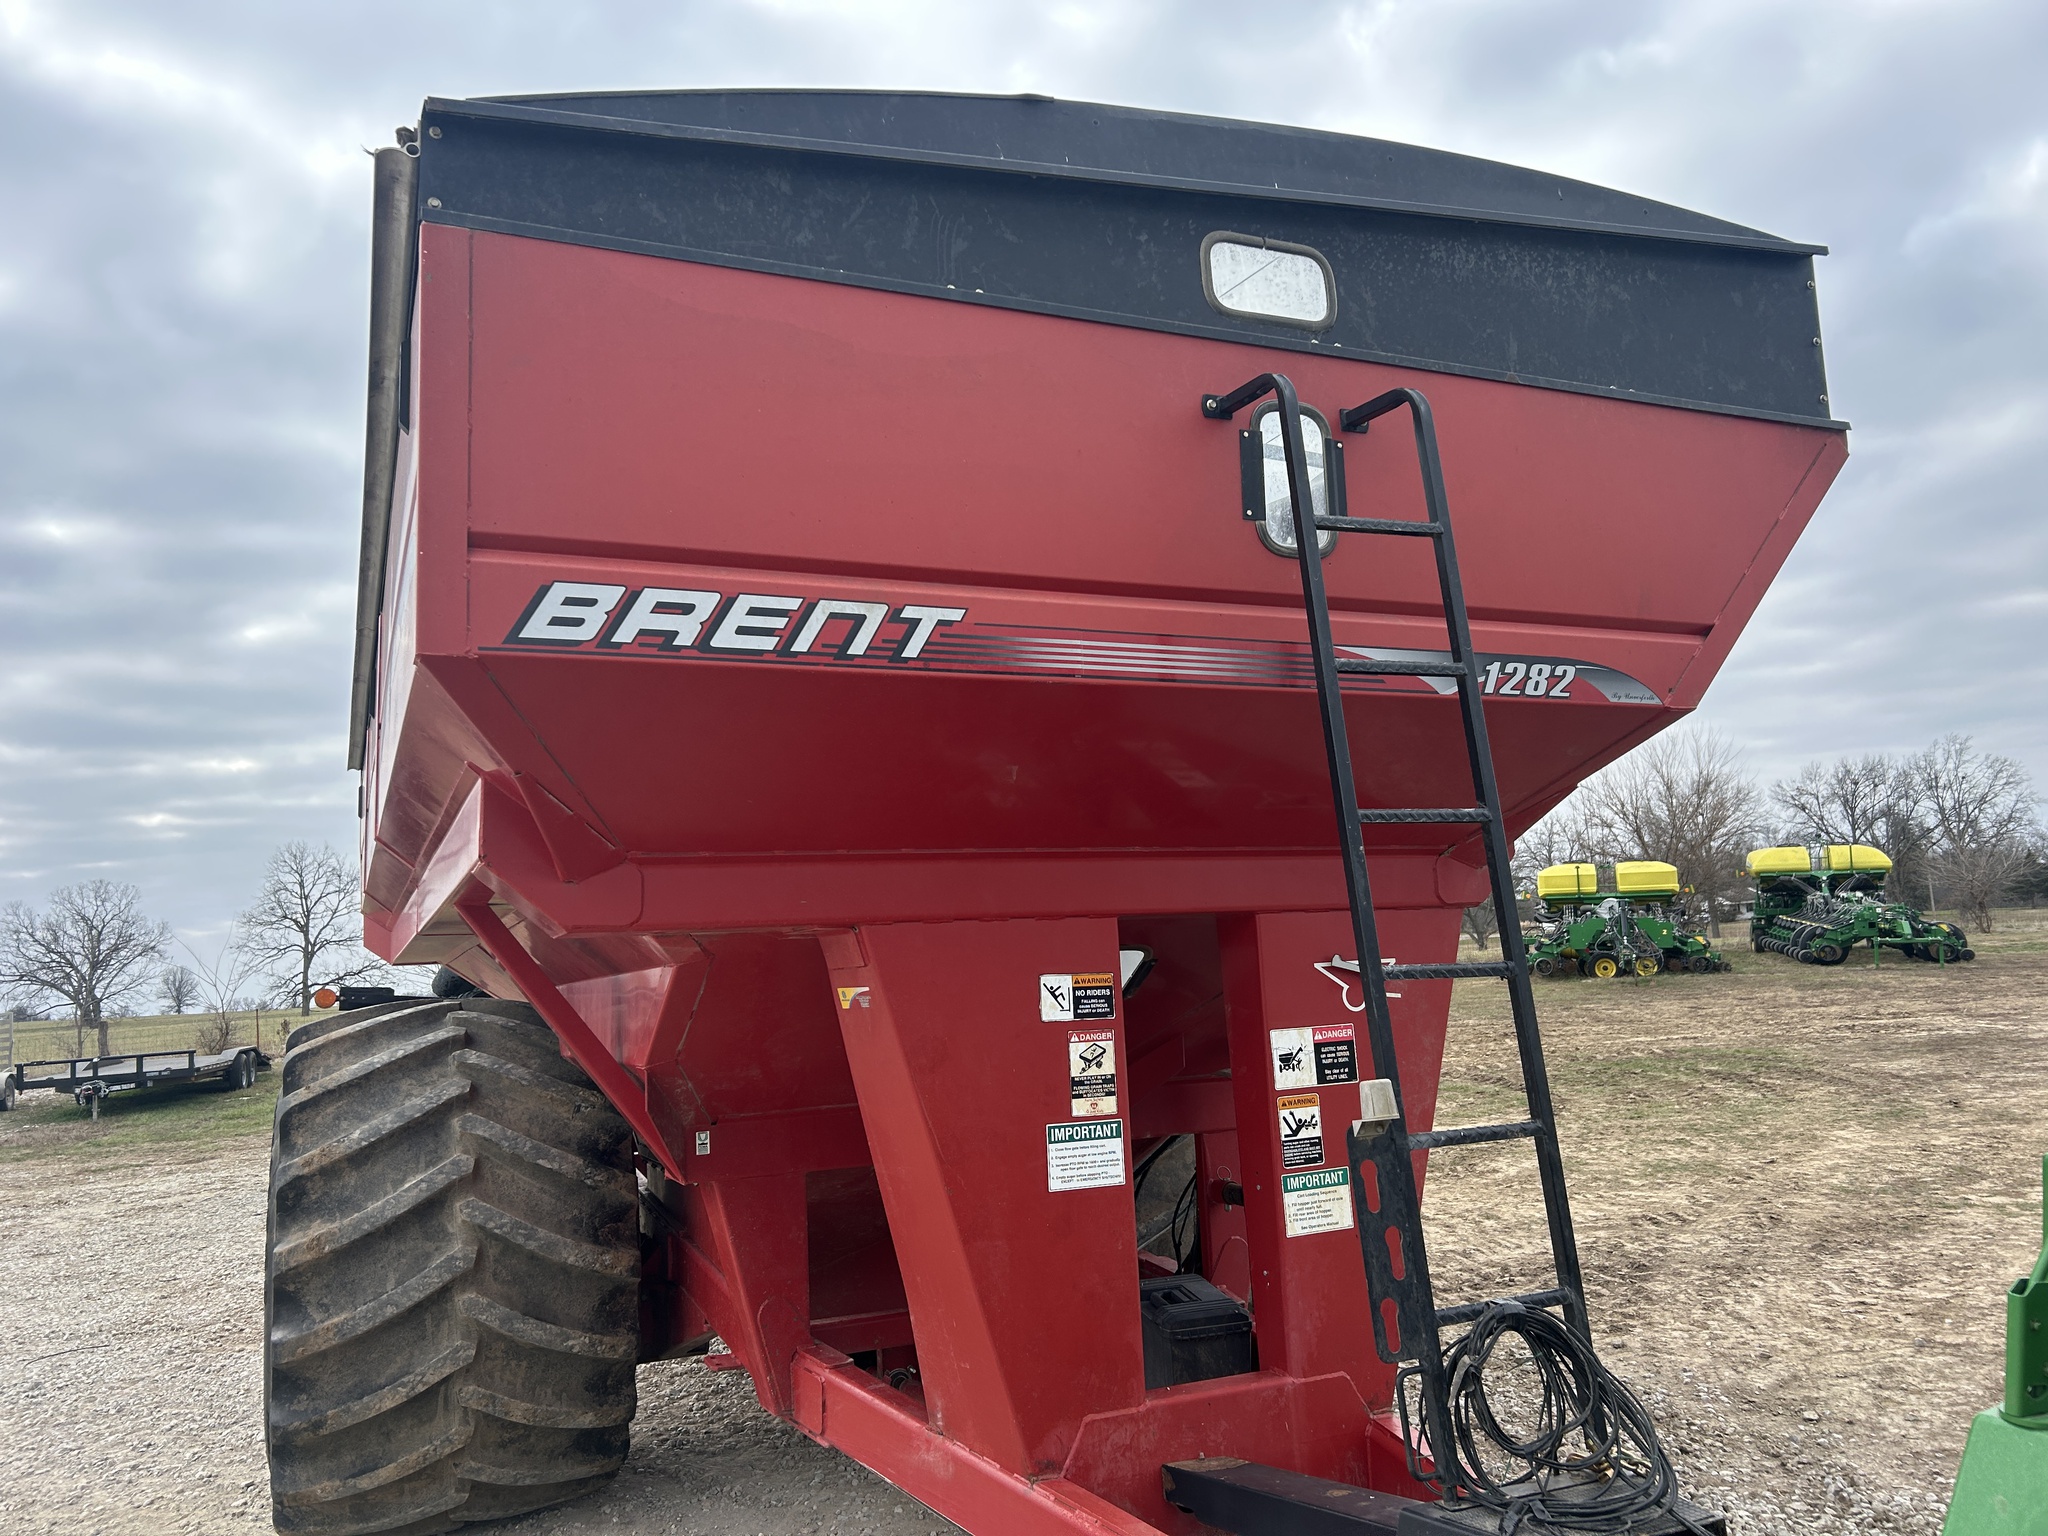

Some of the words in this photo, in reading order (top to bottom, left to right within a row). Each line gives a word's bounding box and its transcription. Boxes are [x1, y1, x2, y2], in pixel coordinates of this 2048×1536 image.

[510, 580, 967, 660] BRENT
[1483, 661, 1577, 698] 1282
[1611, 692, 1621, 700] By
[1322, 1029, 1352, 1038] DANGER
[1288, 1097, 1315, 1106] WARNING
[1051, 1124, 1118, 1141] IMPORTANT
[1287, 1171, 1343, 1189] IMPORTANT
